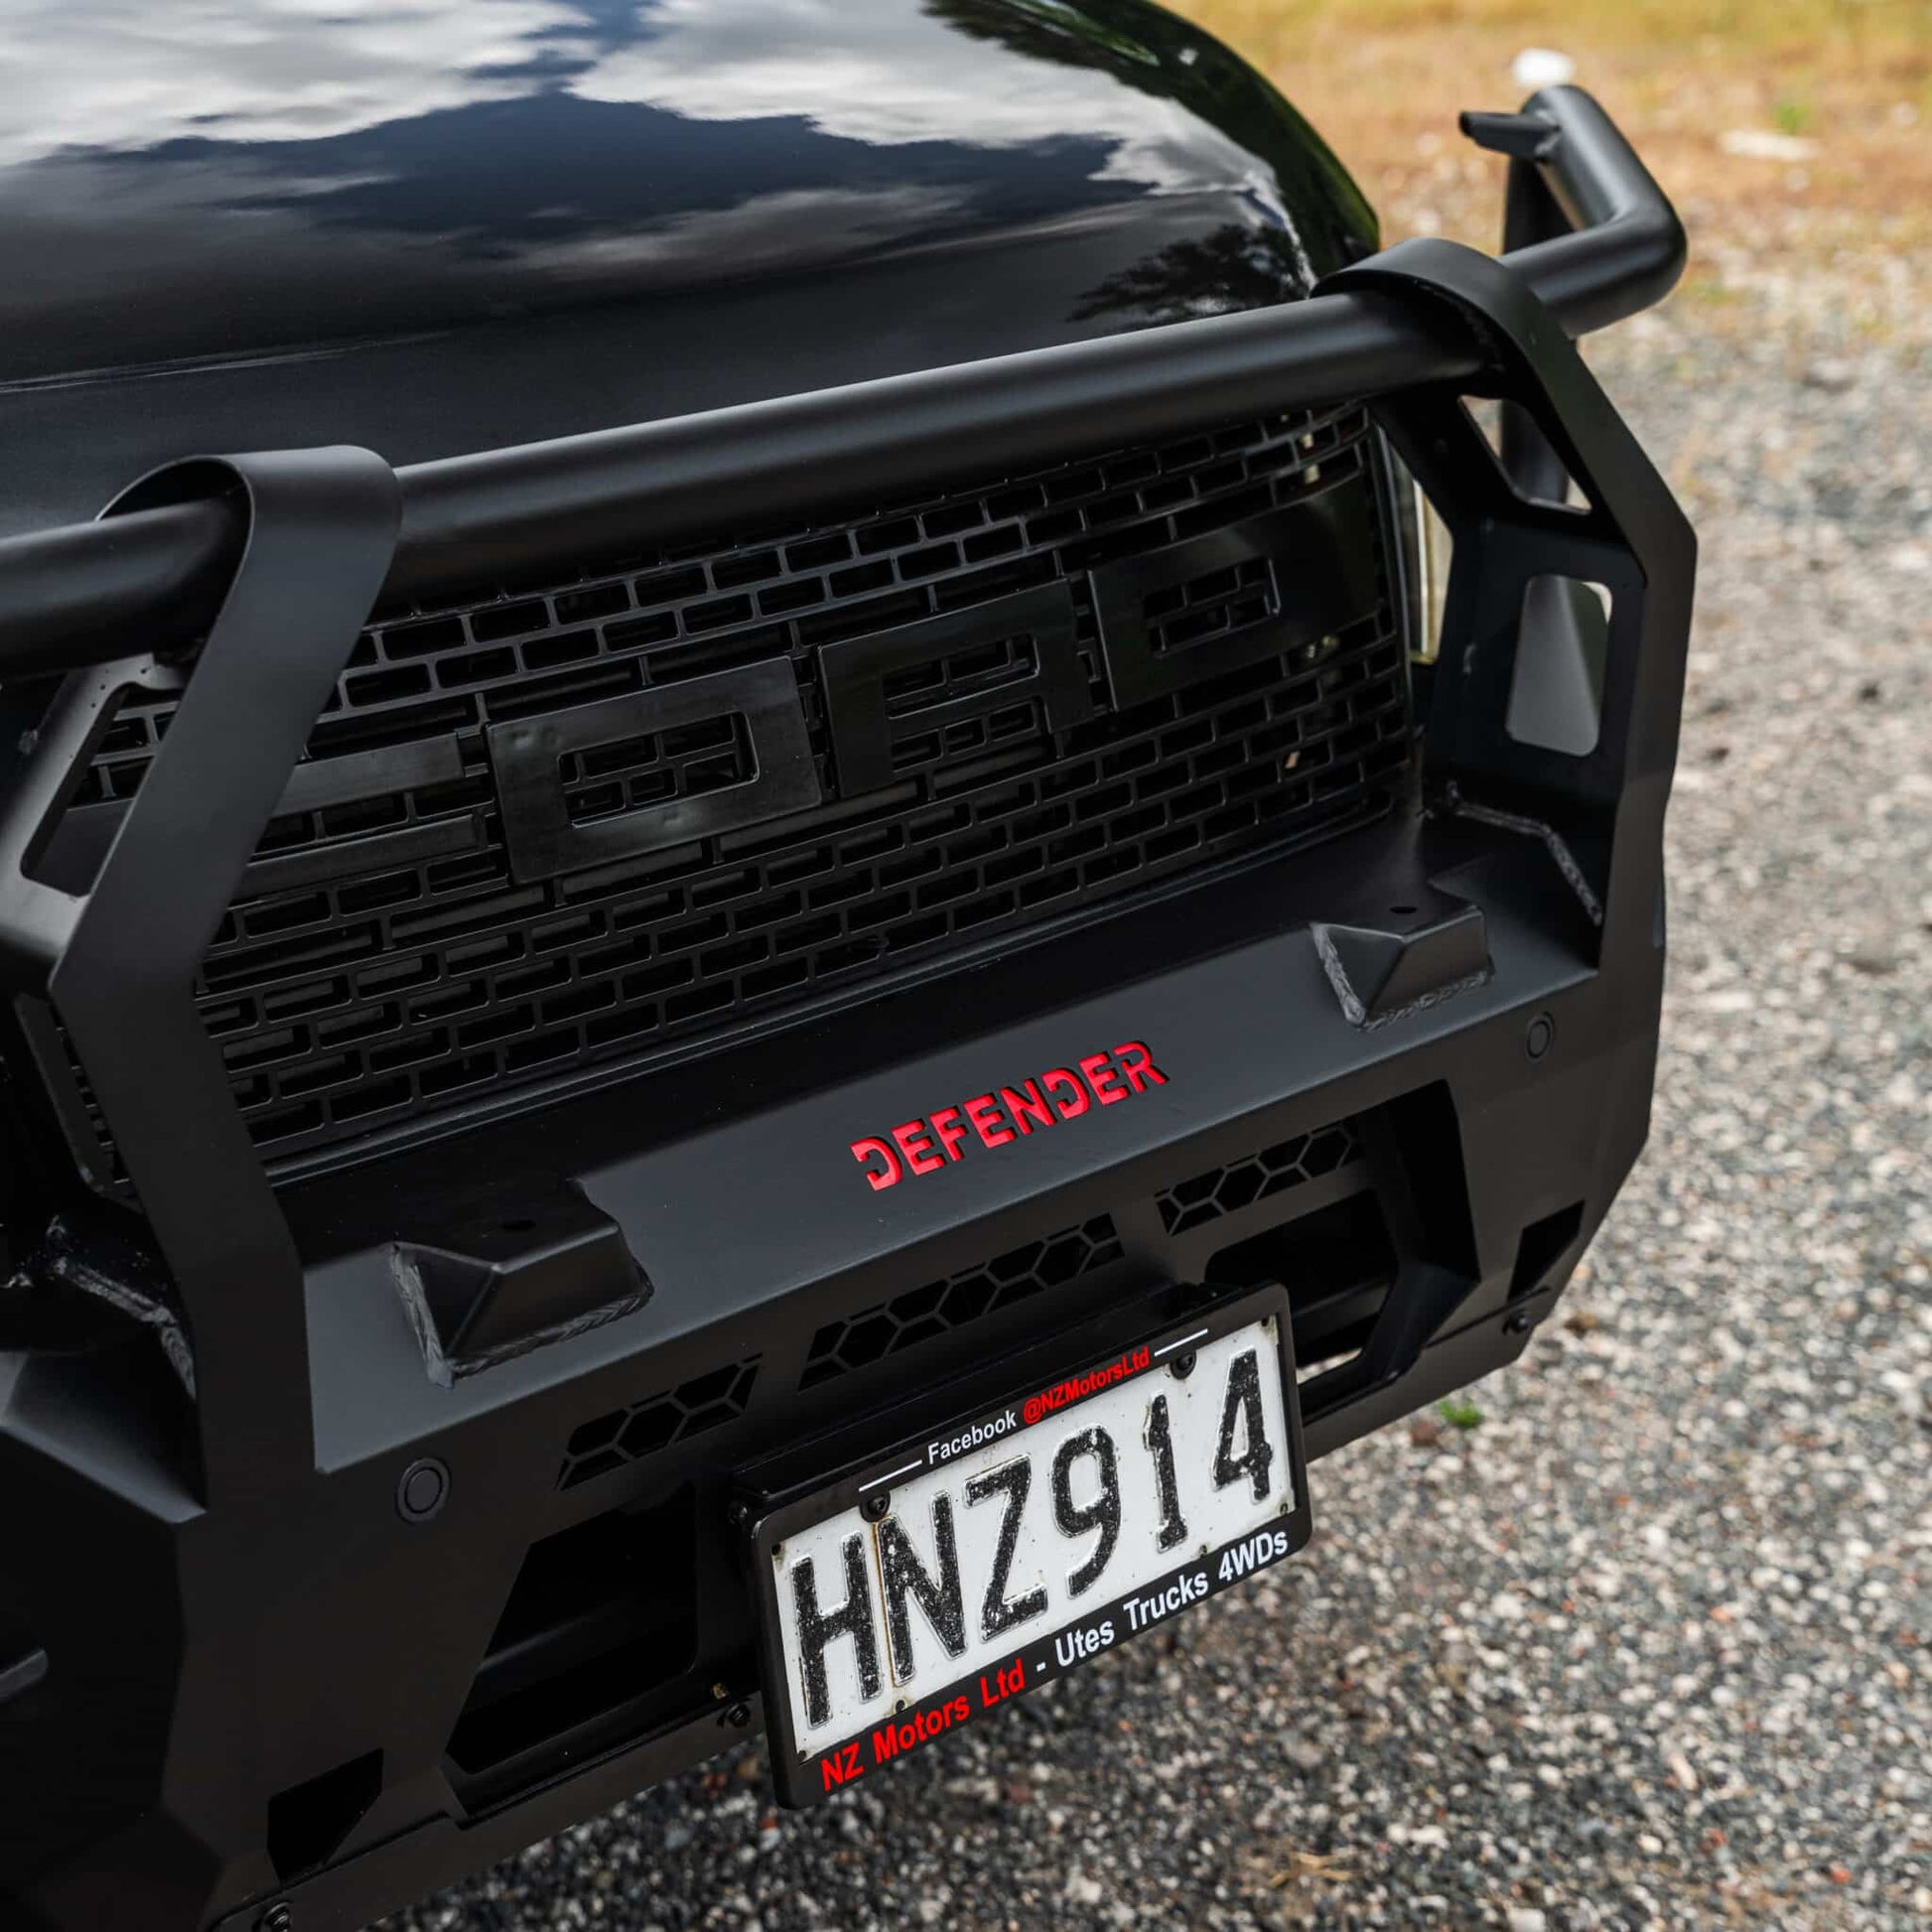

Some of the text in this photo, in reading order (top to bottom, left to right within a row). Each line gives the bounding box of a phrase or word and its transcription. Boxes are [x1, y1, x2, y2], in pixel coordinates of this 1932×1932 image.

[850, 1040, 1169, 1191] DEFENDER
[927, 1345, 1150, 1464] Facebook @NZMotorsLtd
[790, 1345, 1275, 1729] HNZ914
[820, 1742, 864, 1791] NZ
[873, 1696, 970, 1764] Motors
[980, 1657, 1026, 1707] Ltd
[1054, 1618, 1115, 1668] Utes
[1123, 1570, 1209, 1631] Trucks
[1218, 1529, 1288, 1583] 4WDs
